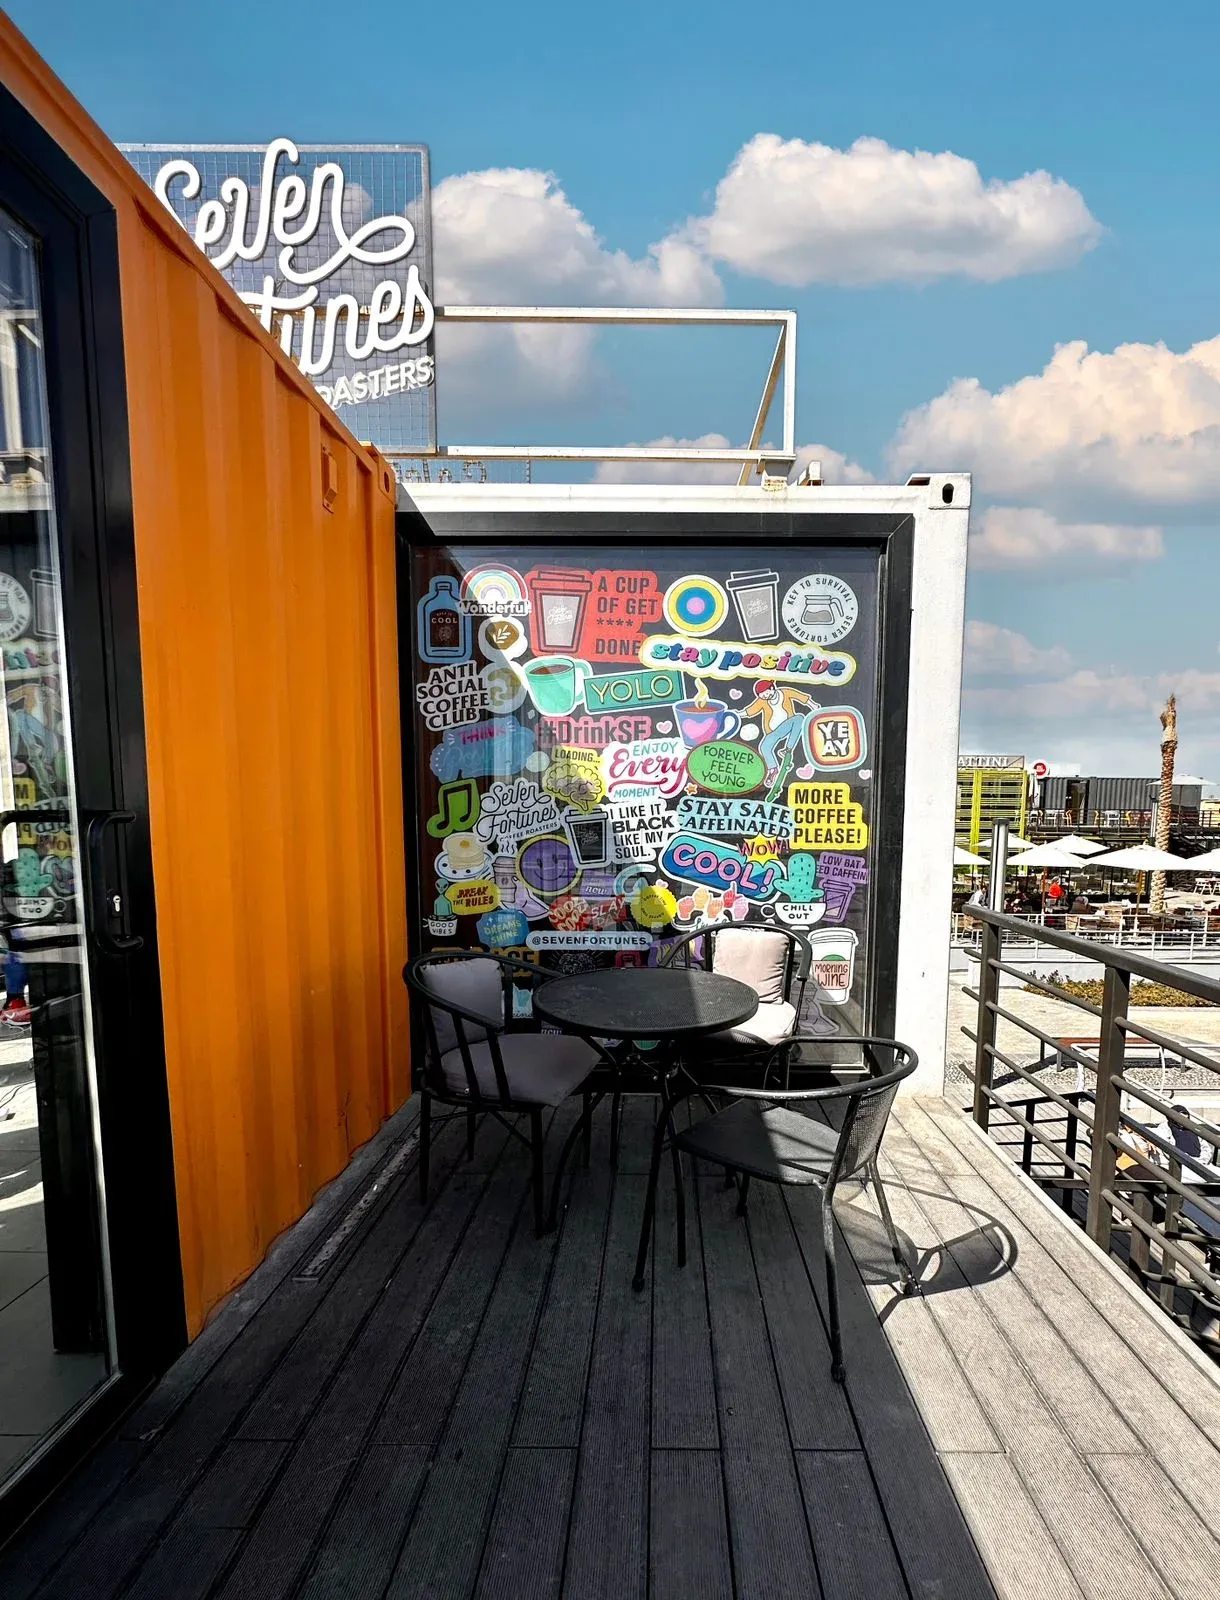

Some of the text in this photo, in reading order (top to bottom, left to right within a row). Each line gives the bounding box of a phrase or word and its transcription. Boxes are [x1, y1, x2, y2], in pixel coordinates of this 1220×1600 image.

[238, 265, 435, 376] tunes
[315, 356, 435, 410] OASTERS
[598, 576, 650, 594] A CUP
[598, 597, 658, 615] OF GET
[787, 577, 853, 642] KEY TO SURVIVAL SEVEN FORTUNES
[595, 638, 641, 656] DONE
[651, 642, 846, 677] stay positive
[430, 663, 474, 685] ANTI
[417, 678, 487, 699] SOCIAL
[591, 675, 673, 704] YOLO
[423, 693, 489, 714] COFFEE
[429, 708, 477, 728] CLUB
[555, 748, 600, 763] LOADING...
[633, 742, 679, 756] ENJOY
[703, 746, 754, 764] FOREVER
[608, 748, 688, 794] Every
[710, 760, 741, 775] FEEL
[701, 771, 746, 788] YOUNG
[481, 781, 552, 813] Seven
[613, 787, 658, 798] MOMENT
[794, 788, 843, 805] MORE
[619, 806, 646, 819] LIKE
[650, 804, 661, 816] IT
[680, 799, 734, 814] STAY
[476, 804, 557, 842] Fortunes
[612, 815, 675, 833] BLACK
[794, 808, 856, 824] COFFEE
[525, 822, 558, 834] ROASTERS
[793, 828, 861, 844] PLEASE!
[614, 834, 640, 846] LIKE
[645, 832, 663, 844] MY
[615, 846, 651, 859] SOUL.
[673, 844, 775, 893] COOL!
[823, 855, 861, 869] LOW BAT
[457, 886, 488, 898] BREAK
[465, 895, 494, 907] RULES
[531, 935, 647, 945] @SEVENFORTUNES
[817, 973, 845, 987] WINE
